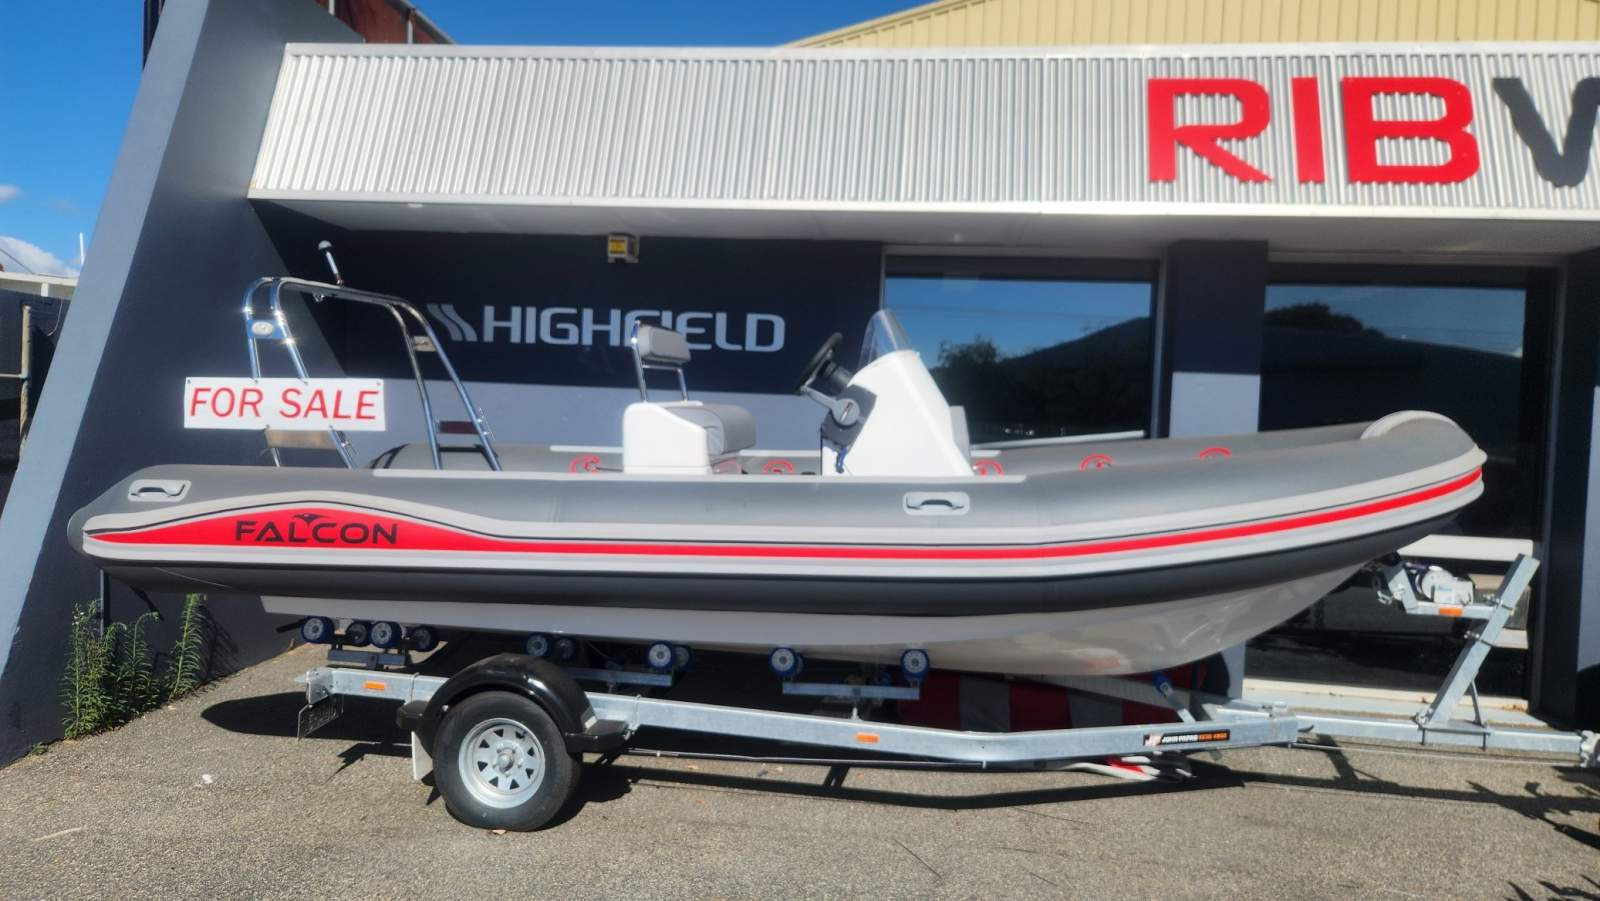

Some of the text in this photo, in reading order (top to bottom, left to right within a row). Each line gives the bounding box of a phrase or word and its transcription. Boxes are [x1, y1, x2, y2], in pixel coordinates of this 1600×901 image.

[190, 387, 379, 420] FOR SALE
[235, 519, 398, 545] FALCON
